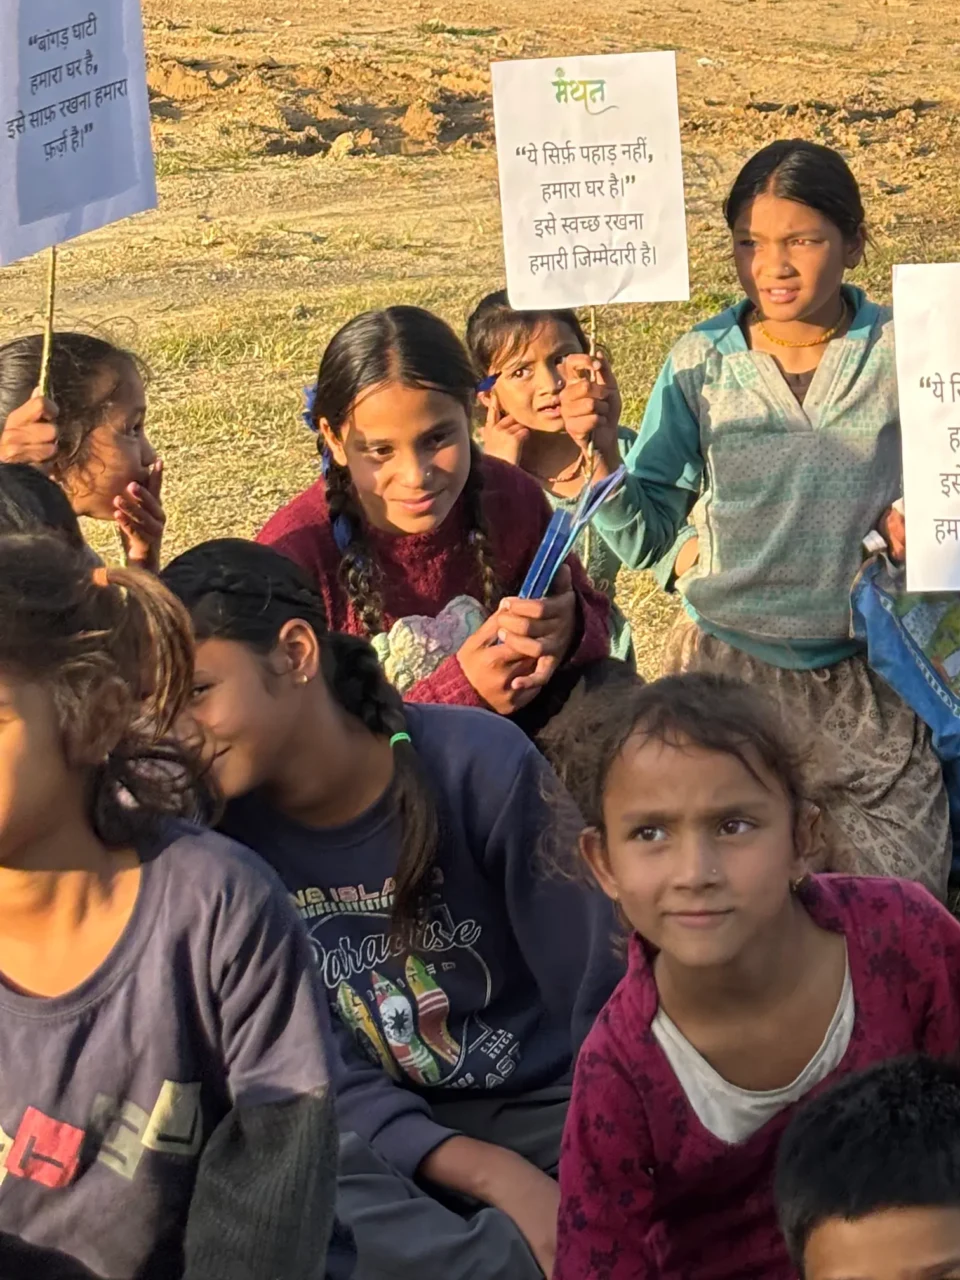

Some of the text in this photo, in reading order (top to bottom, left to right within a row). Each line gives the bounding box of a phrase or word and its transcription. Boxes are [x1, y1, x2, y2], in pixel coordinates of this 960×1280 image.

[71, 11, 98, 41] घाटी
[29, 64, 64, 97] हमारा
[65, 60, 83, 79] घर
[551, 67, 620, 115] मंथन
[6, 77, 129, 140] इसे साफ़ रखना हमारा
[515, 142, 539, 167] “ये
[579, 143, 618, 167] पहाड़
[620, 136, 654, 164] नहीं,
[540, 180, 582, 204] हमारा
[584, 179, 605, 198] घर
[533, 211, 645, 239] इसे स्वच्छ रखना
[528, 240, 657, 276] हमारी जिम्मेदारी है।
[919, 372, 946, 404] “ये
